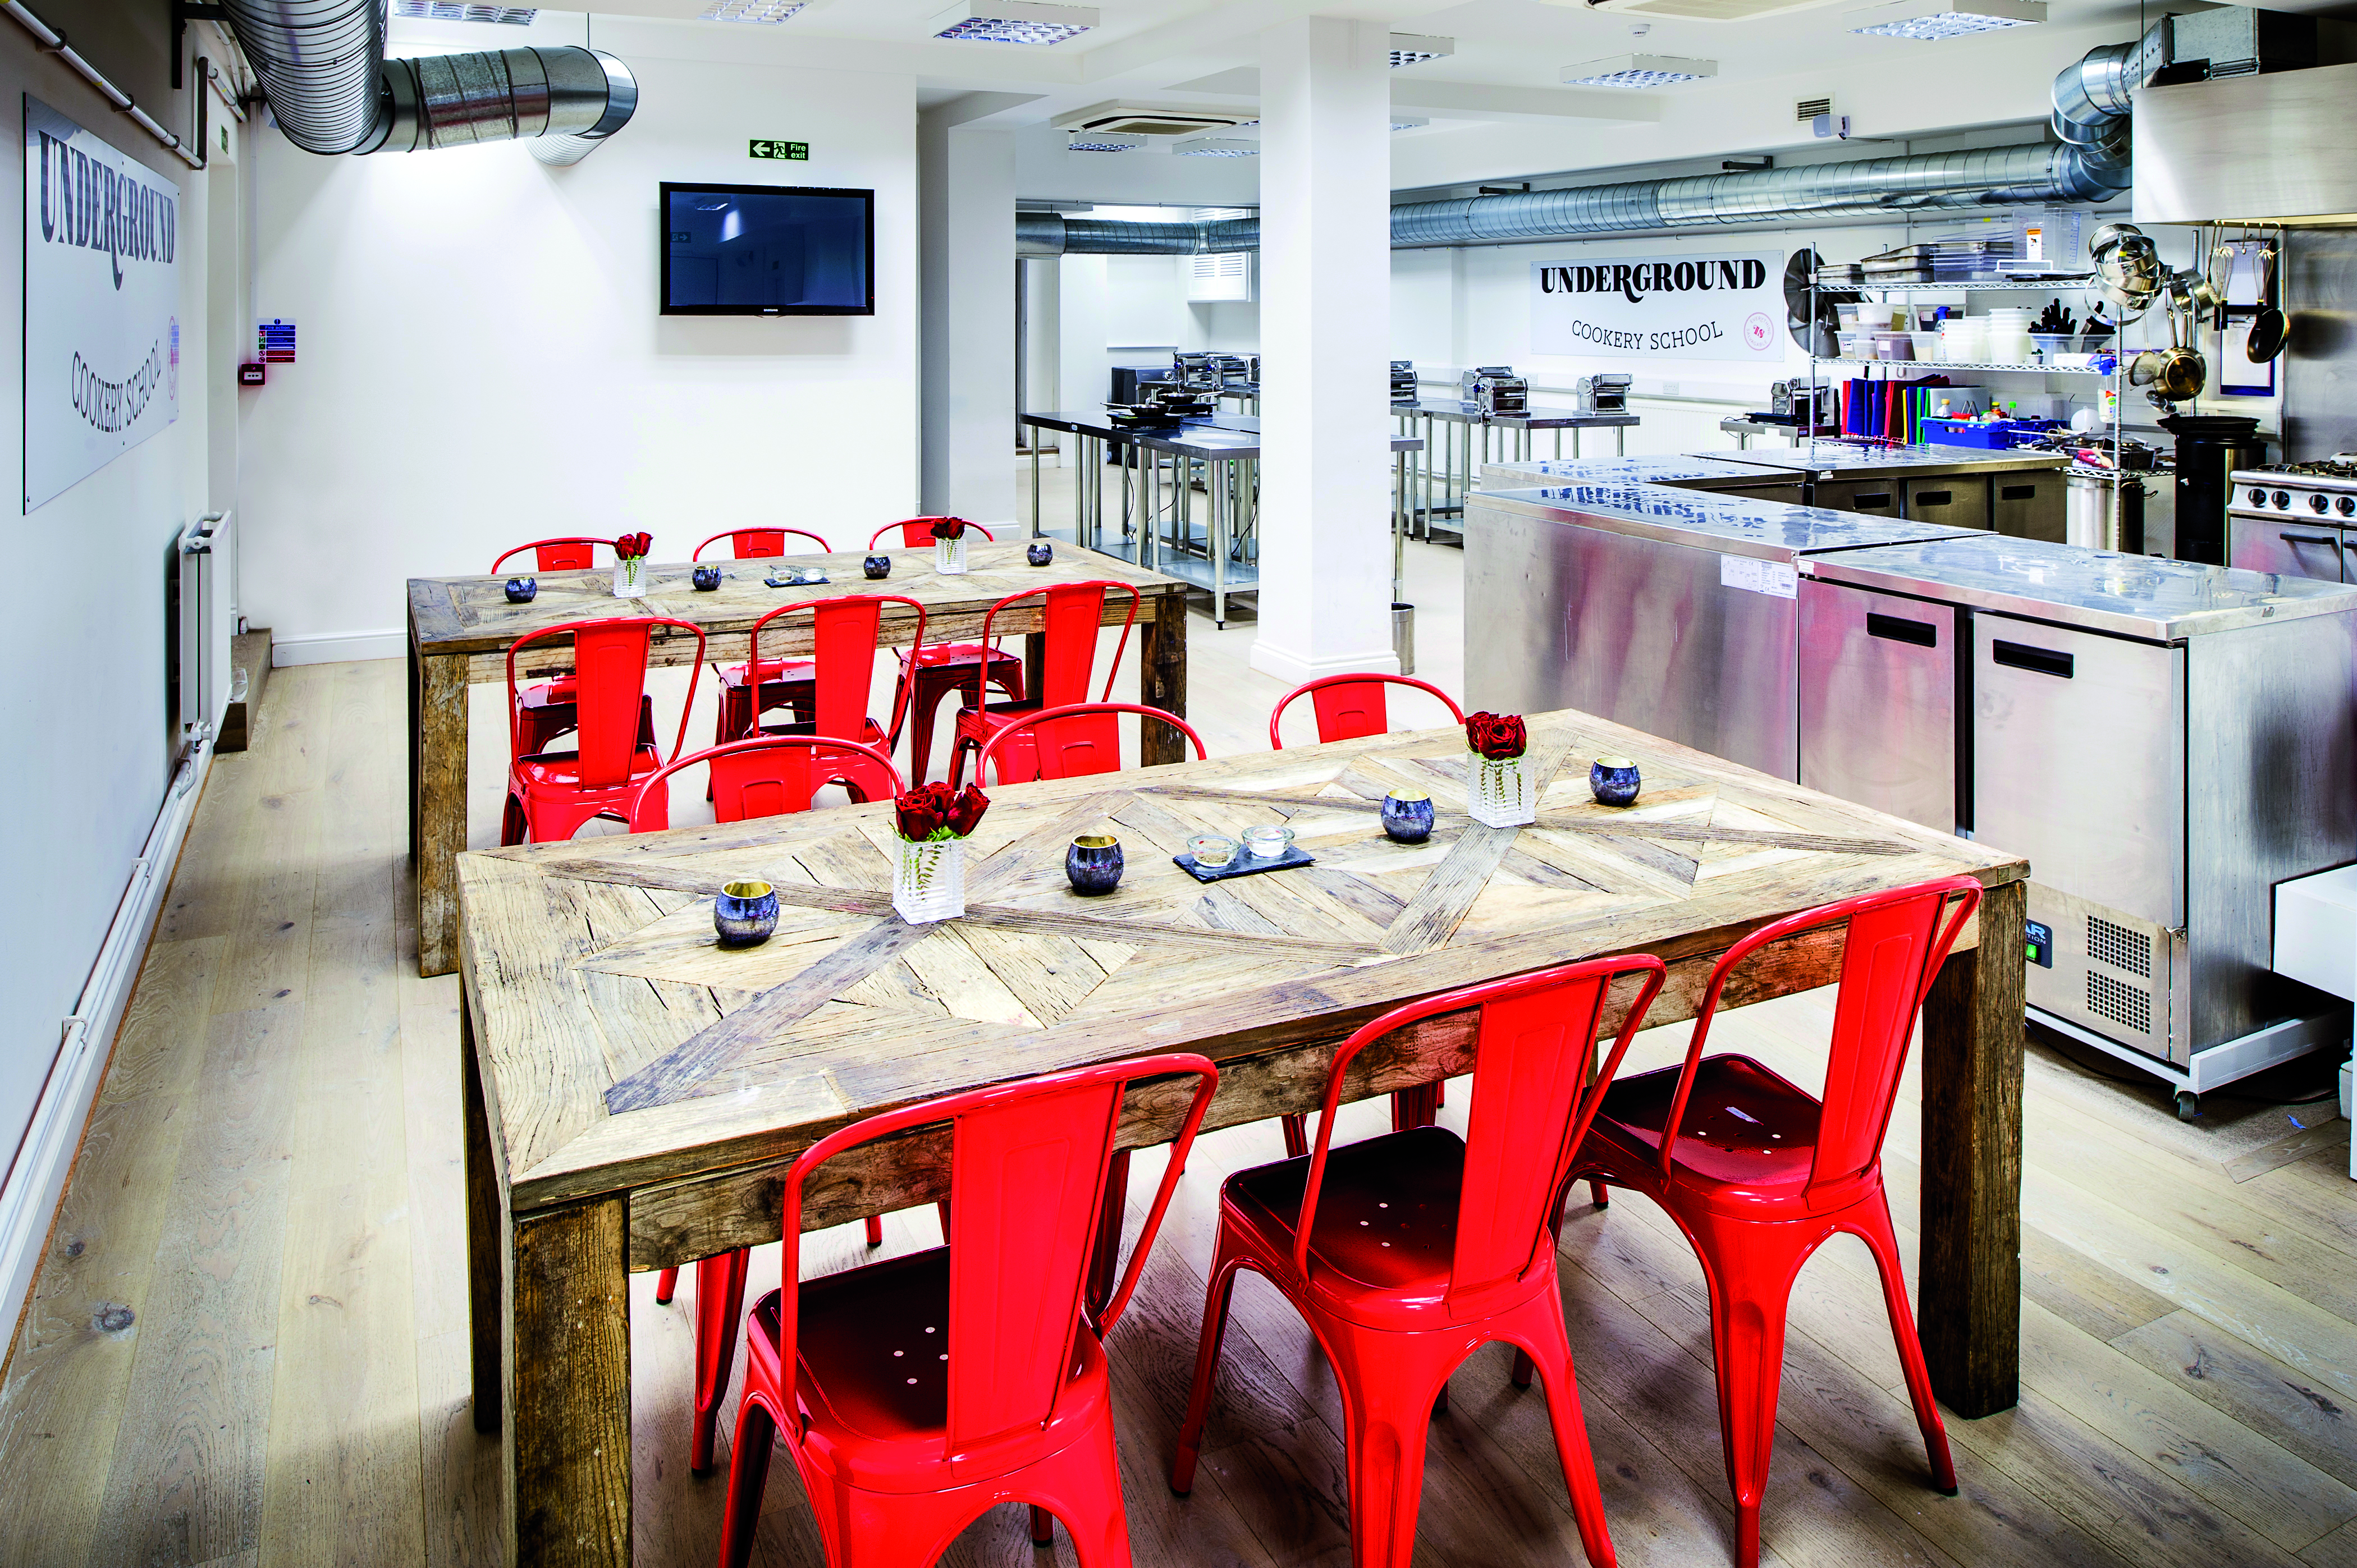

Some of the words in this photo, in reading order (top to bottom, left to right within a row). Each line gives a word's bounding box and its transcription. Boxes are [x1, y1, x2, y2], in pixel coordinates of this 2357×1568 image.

[38, 130, 175, 291] UNDERGROUND
[1540, 259, 1766, 304] UNDERGROUND
[1572, 320, 1644, 350] COOKERY
[1650, 321, 1723, 350] SCHOOL
[1750, 316, 1771, 336] EVERYTHING
[72, 351, 123, 433] COOKERY
[126, 338, 161, 428] SCHOOL
